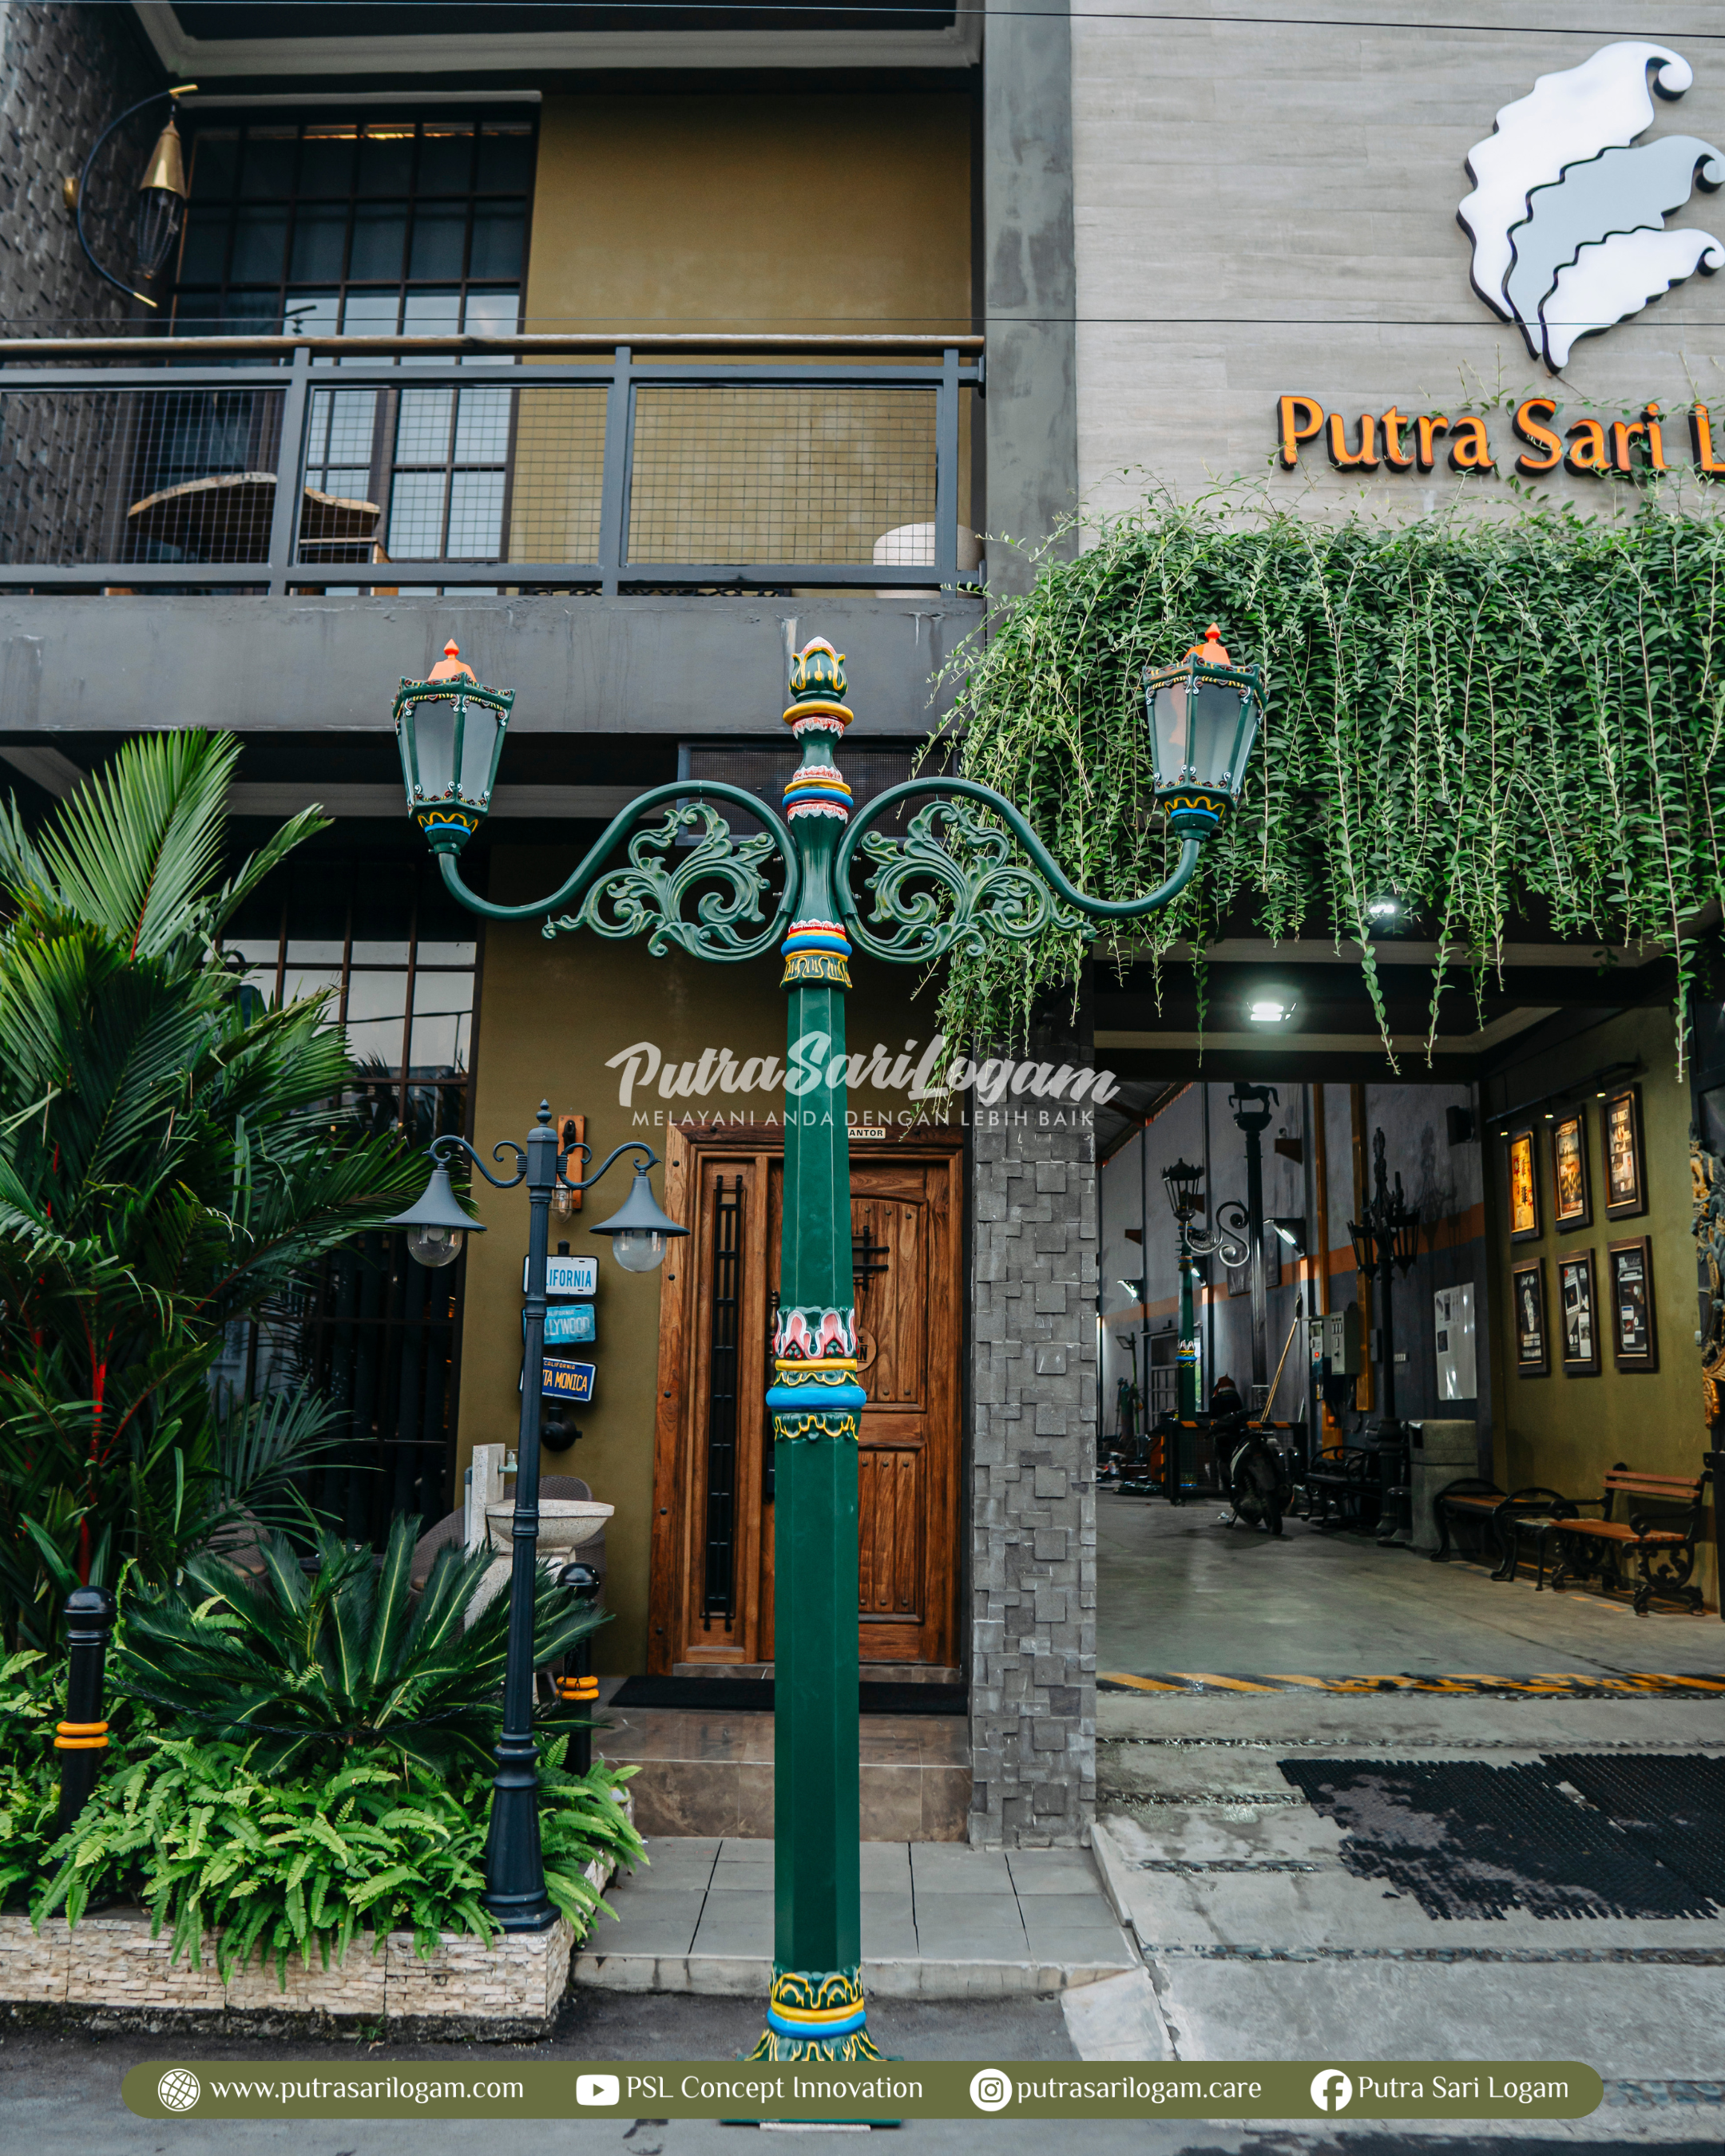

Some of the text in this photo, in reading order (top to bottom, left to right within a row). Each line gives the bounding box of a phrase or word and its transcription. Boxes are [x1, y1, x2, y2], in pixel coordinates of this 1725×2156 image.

[1279, 395, 1496, 473] Putra
[1514, 398, 1670, 474] Sari
[546, 1269, 592, 1287] IFORNIA
[544, 1361, 575, 1369] CALIFORNIA
[554, 1371, 588, 1392] MONICA
